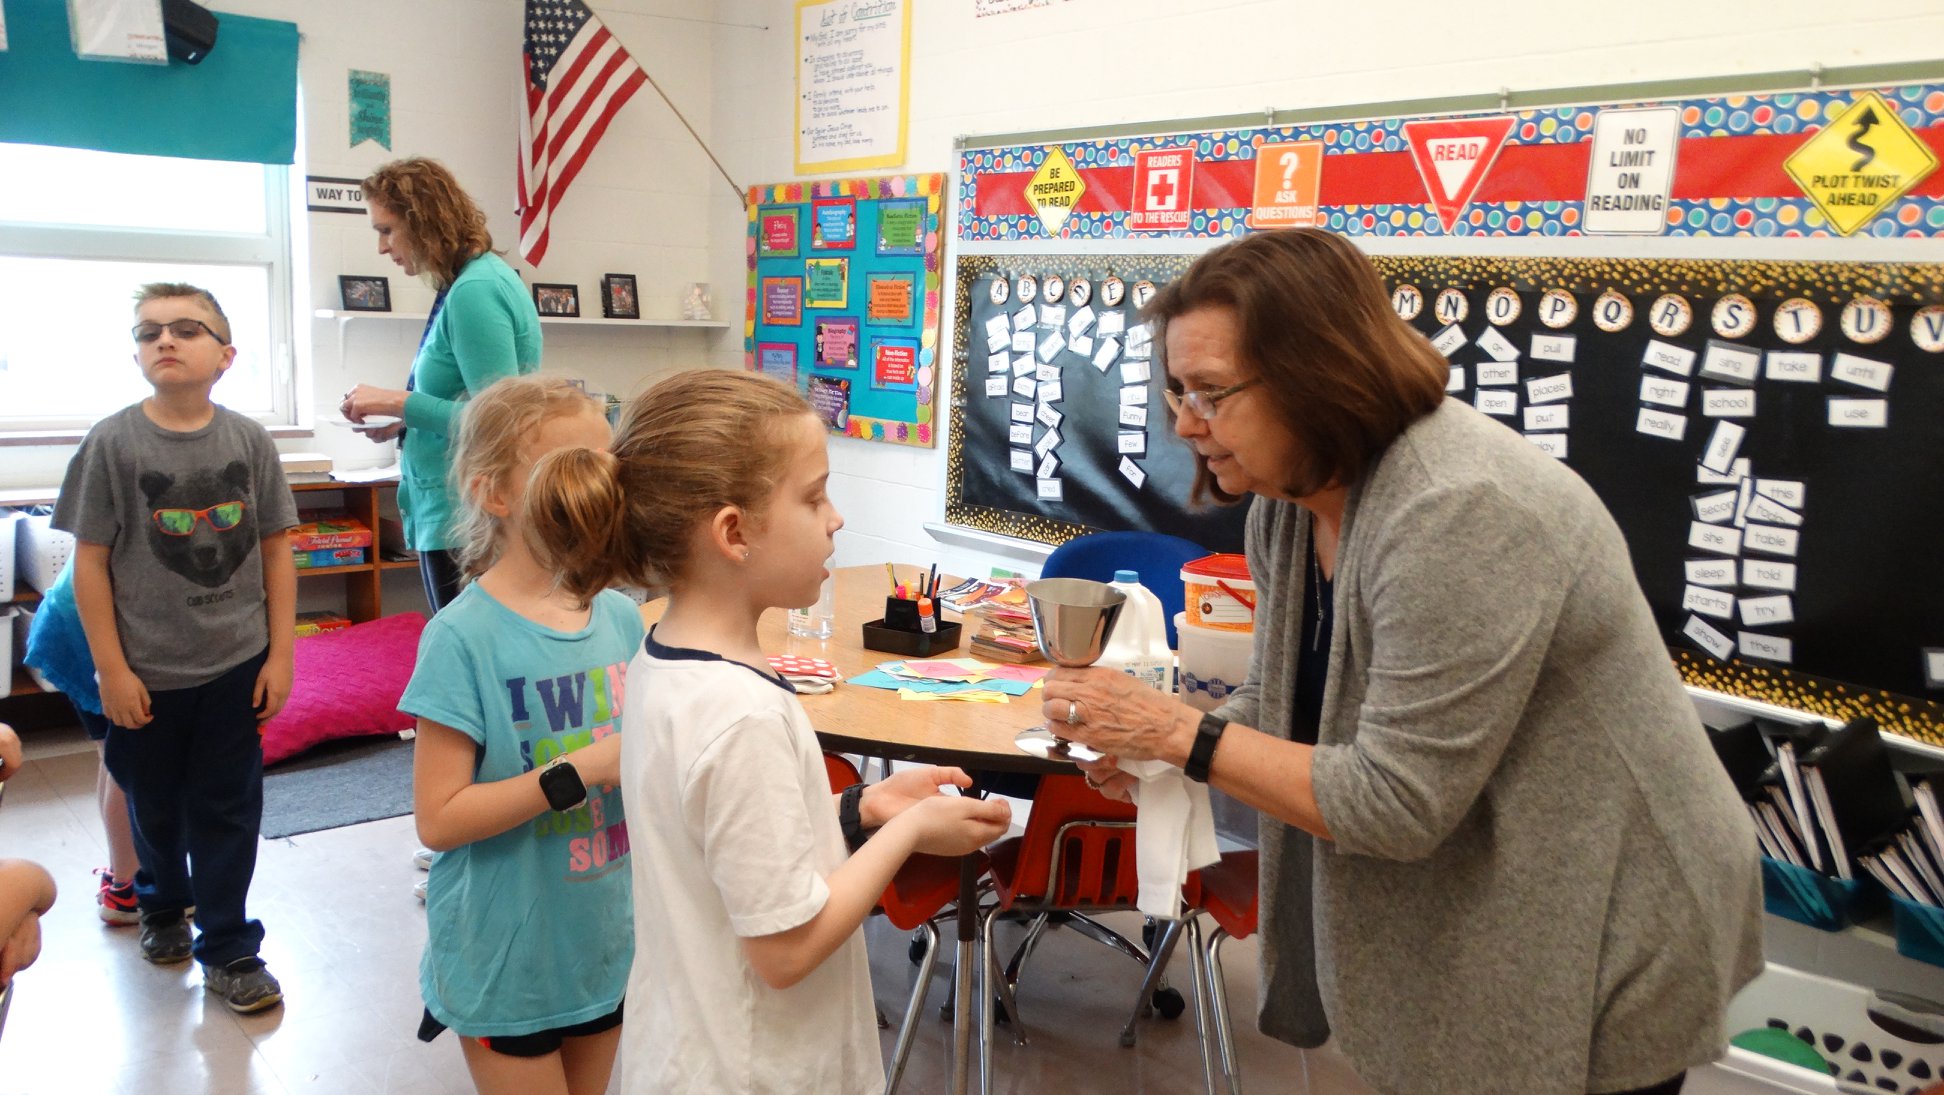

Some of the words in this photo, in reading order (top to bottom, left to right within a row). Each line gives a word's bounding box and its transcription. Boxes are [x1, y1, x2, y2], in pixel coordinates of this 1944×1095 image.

[1623, 128, 1647, 145] NO
[1434, 142, 1480, 161] READ
[1609, 150, 1656, 168] LIMIT
[1147, 154, 1182, 168] READERS
[1049, 167, 1060, 179] BE
[1618, 172, 1640, 189] ON
[1033, 181, 1075, 195] PREPARED
[1811, 175, 1849, 189] PLOT
[1851, 174, 1900, 189] TWIST
[316, 187, 343, 200] WAY
[346, 189, 362, 202] TO
[1274, 190, 1297, 203] ASK
[1826, 192, 1879, 206] AHEAD
[1037, 198, 1047, 209] TO
[1049, 196, 1071, 207] READ
[1590, 194, 1662, 212] READING
[1133, 211, 1143, 223] TO
[1145, 211, 1159, 223] THE
[1160, 210, 1188, 223] RESCUE
[1255, 205, 1313, 220] QUESTIONS
[994, 283, 1003, 297] A
[1022, 282, 1031, 297] B
[1050, 280, 1058, 297] C
[1074, 284, 1086, 300] D
[1108, 282, 1116, 301] E
[1398, 292, 1415, 314] M
[1443, 294, 1459, 317] N
[1494, 296, 1510, 318] O
[1549, 297, 1566, 319] P
[1603, 300, 1621, 323] Q
[1658, 302, 1680, 328] R
[1722, 303, 1743, 330] S
[1785, 307, 1806, 333] T
[1854, 307, 1875, 334] U
[1924, 315, 1944, 342] V
[1543, 343, 1562, 354] pull
[1656, 351, 1681, 366] read
[1718, 358, 1742, 373] sing
[1776, 360, 1808, 372] take
[1482, 368, 1510, 379] other
[1532, 381, 1566, 399] places
[1650, 386, 1678, 399] right
[1484, 398, 1507, 410] open
[1708, 396, 1748, 409] school
[1535, 412, 1554, 424] put
[1844, 409, 1869, 418] use
[1644, 417, 1675, 433] really
[1769, 486, 1794, 499] this
[1703, 532, 1724, 545] she
[1755, 531, 1787, 547] table
[1694, 568, 1725, 580] sleep
[1756, 567, 1781, 580] told
[1687, 594, 1728, 610] starts
[1693, 626, 1721, 649] show
[1750, 639, 1778, 654] they
[505, 676, 530, 722] I
